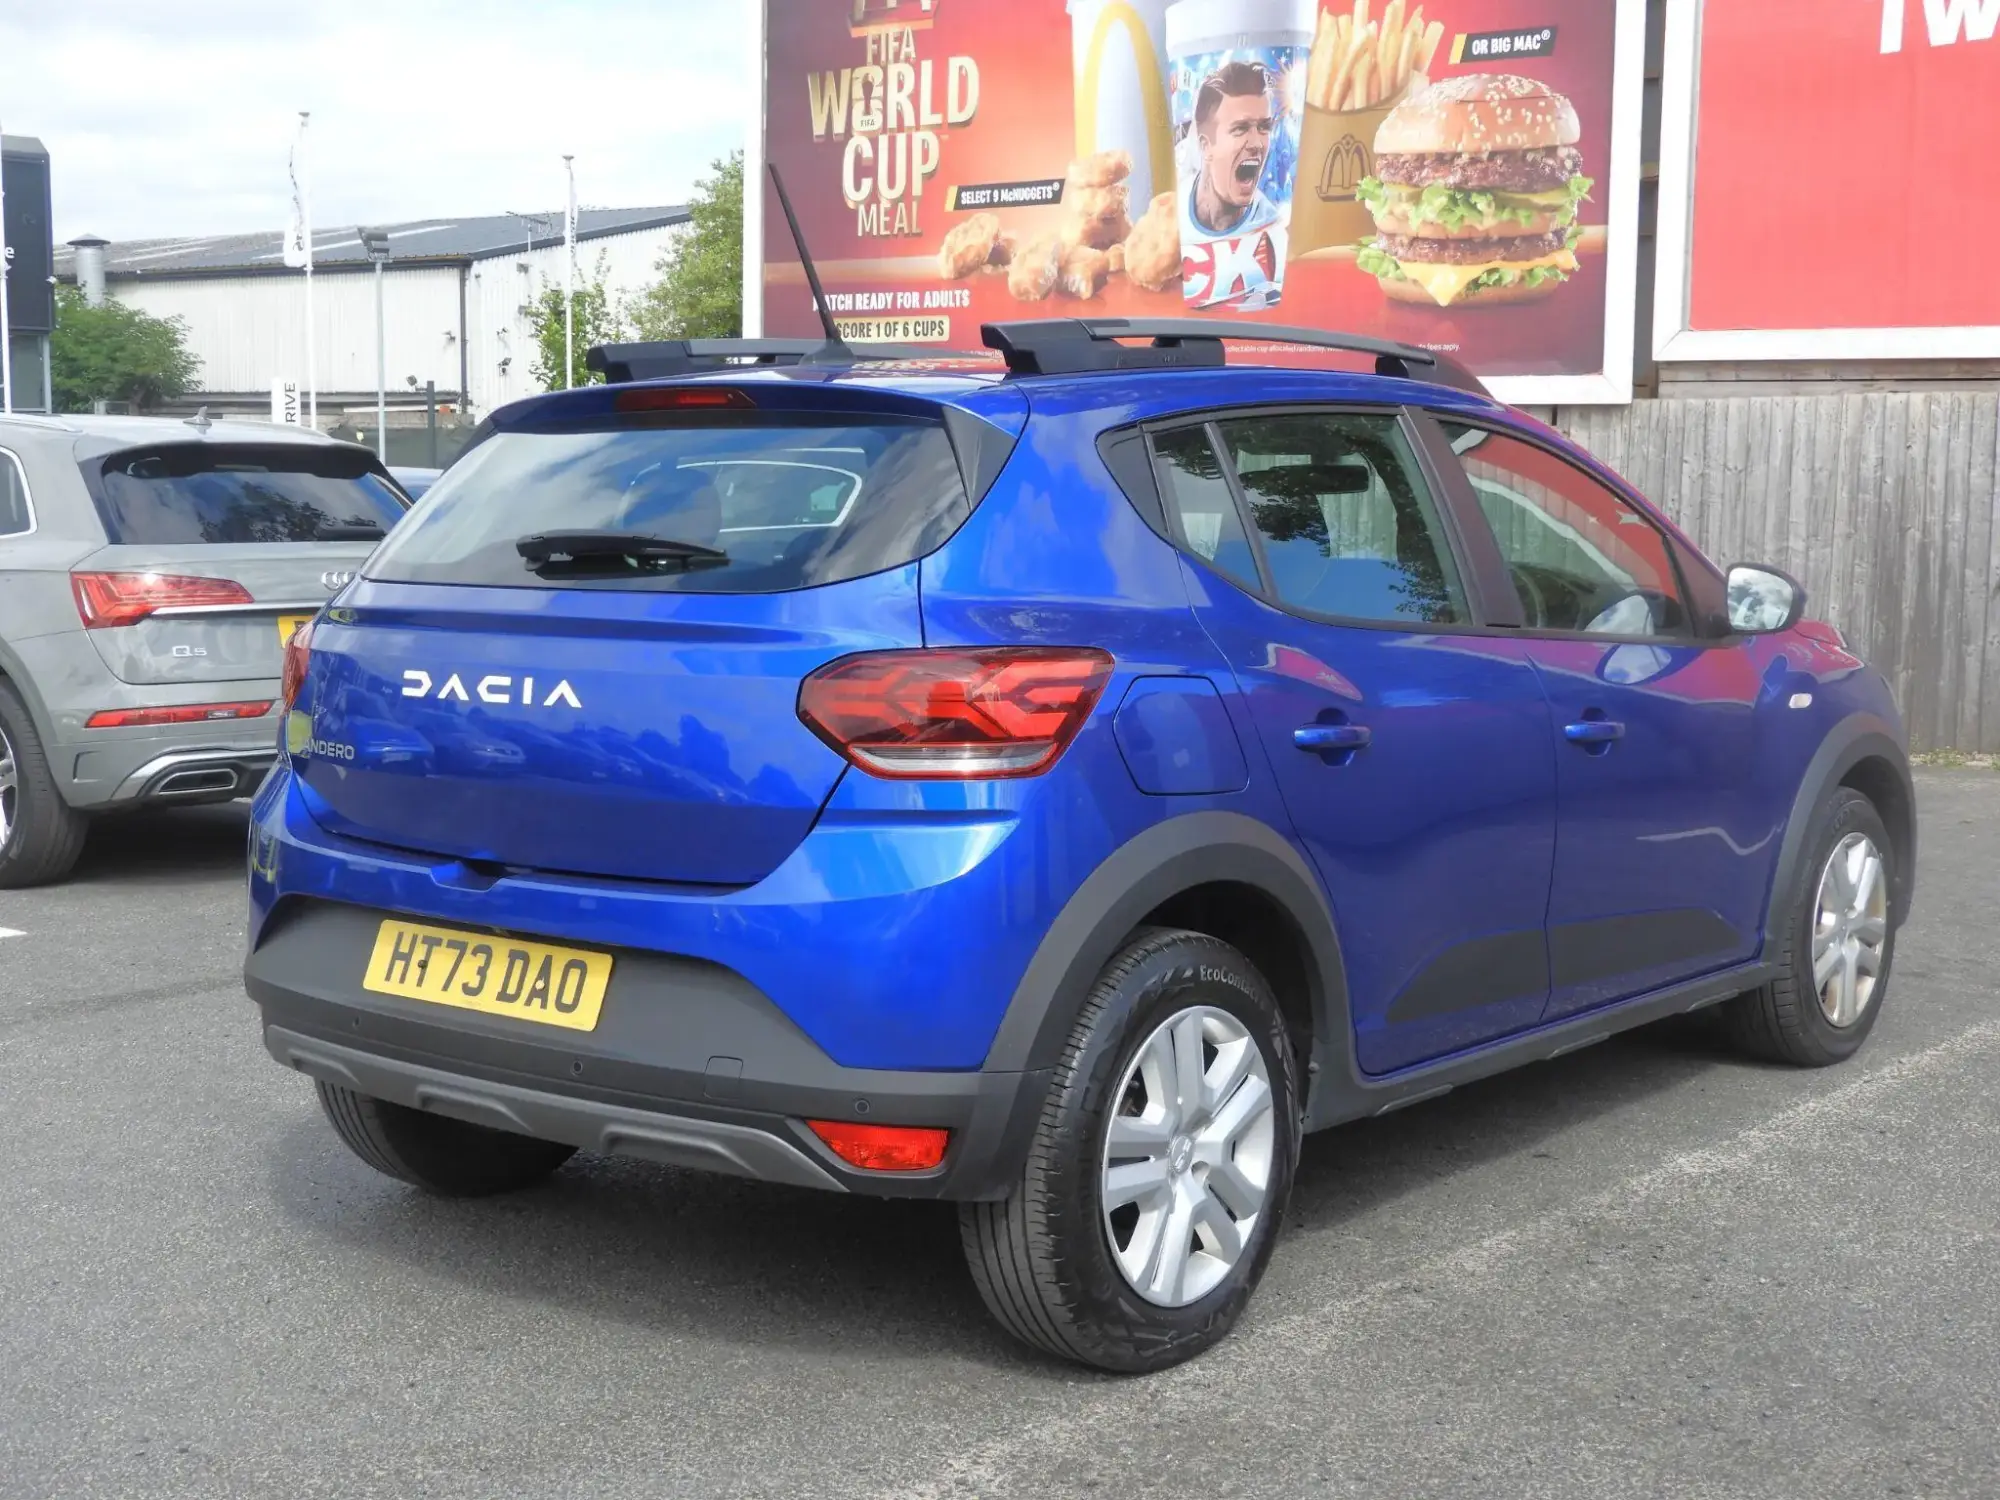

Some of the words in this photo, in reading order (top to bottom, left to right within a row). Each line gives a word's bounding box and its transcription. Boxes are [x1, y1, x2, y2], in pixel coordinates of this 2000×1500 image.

[866, 26, 917, 66] FIFA
[1472, 39, 1488, 55] OR
[1490, 36, 1511, 54] BIG
[860, 118, 876, 127] FIFA
[842, 130, 940, 203] CUP
[961, 189, 992, 205] SELECT
[992, 188, 999, 203] 9
[857, 200, 922, 238] MEAL
[855, 292, 894, 311] READY
[897, 291, 921, 309] FOR
[923, 289, 971, 308] ADULTS
[875, 323, 881, 338] 1
[884, 322, 899, 338] OF
[903, 321, 909, 337] 6
[913, 320, 945, 337] CUPS
[172, 645, 207, 657] Q5
[401, 669, 583, 709] DACIA
[384, 931, 494, 998] HT73
[495, 948, 589, 1014] DAO
